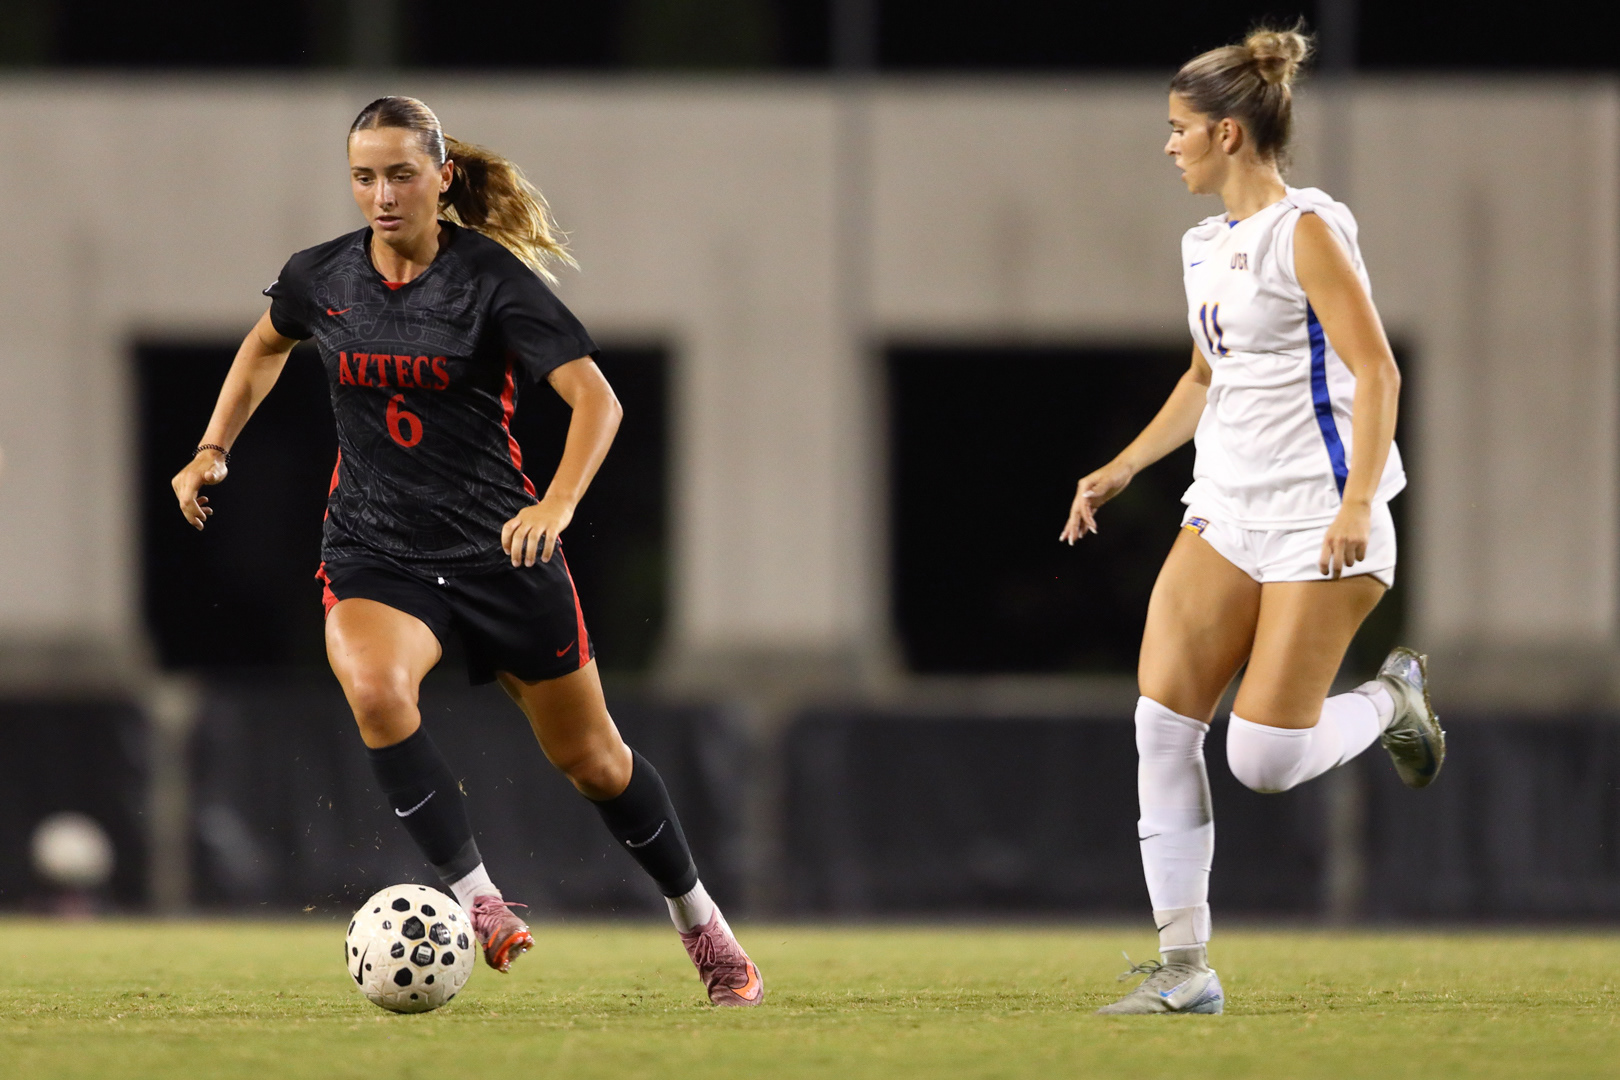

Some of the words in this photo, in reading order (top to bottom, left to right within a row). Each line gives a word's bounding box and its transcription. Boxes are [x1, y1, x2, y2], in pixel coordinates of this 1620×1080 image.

[1199, 301, 1230, 356] 11
[339, 351, 450, 390] AZTECS
[386, 393, 423, 448] 6
